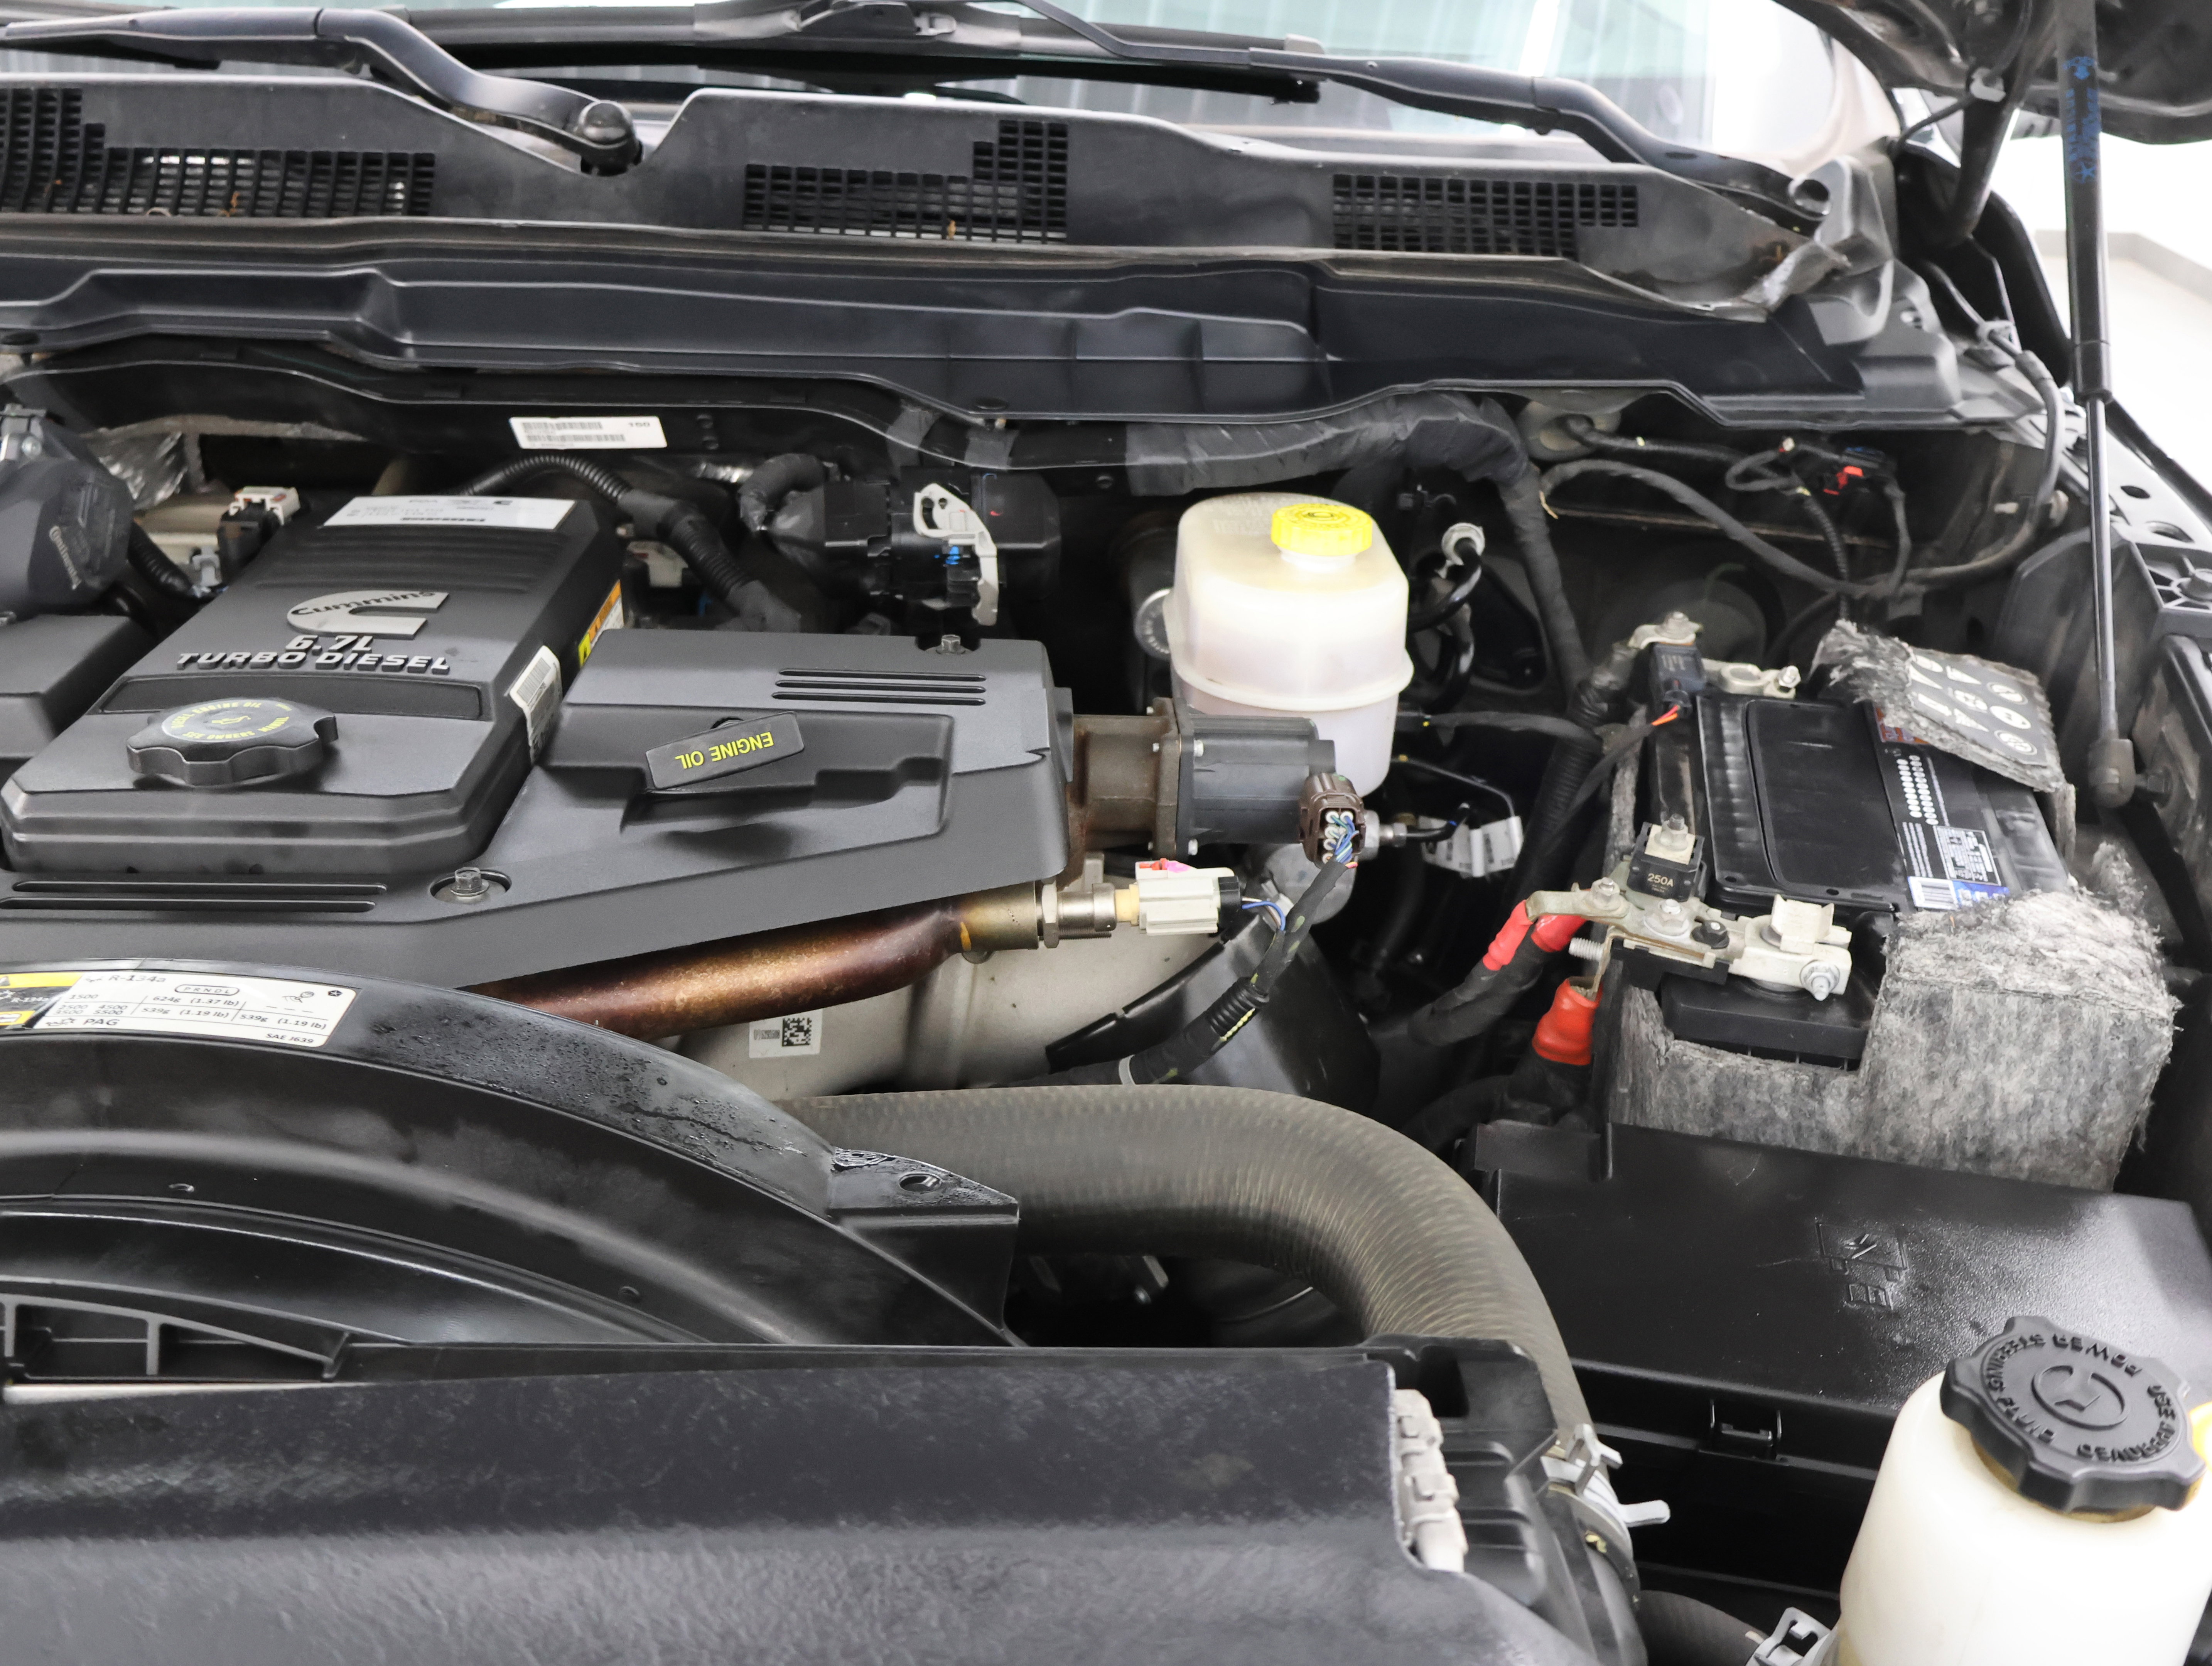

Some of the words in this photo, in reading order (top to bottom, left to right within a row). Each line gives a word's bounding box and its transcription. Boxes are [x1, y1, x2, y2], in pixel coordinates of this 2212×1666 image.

[291, 590, 436, 615] Cummins
[285, 635, 373, 655] 6.7L
[177, 652, 307, 670] TURBO
[316, 653, 450, 674] DIESEL
[708, 732, 774, 762] ENGINE
[675, 750, 705, 769] OIL
[1647, 873, 1674, 887] 250A
[240, 1014, 269, 1022] 539g
[2052, 1333, 2143, 1377] POWER
